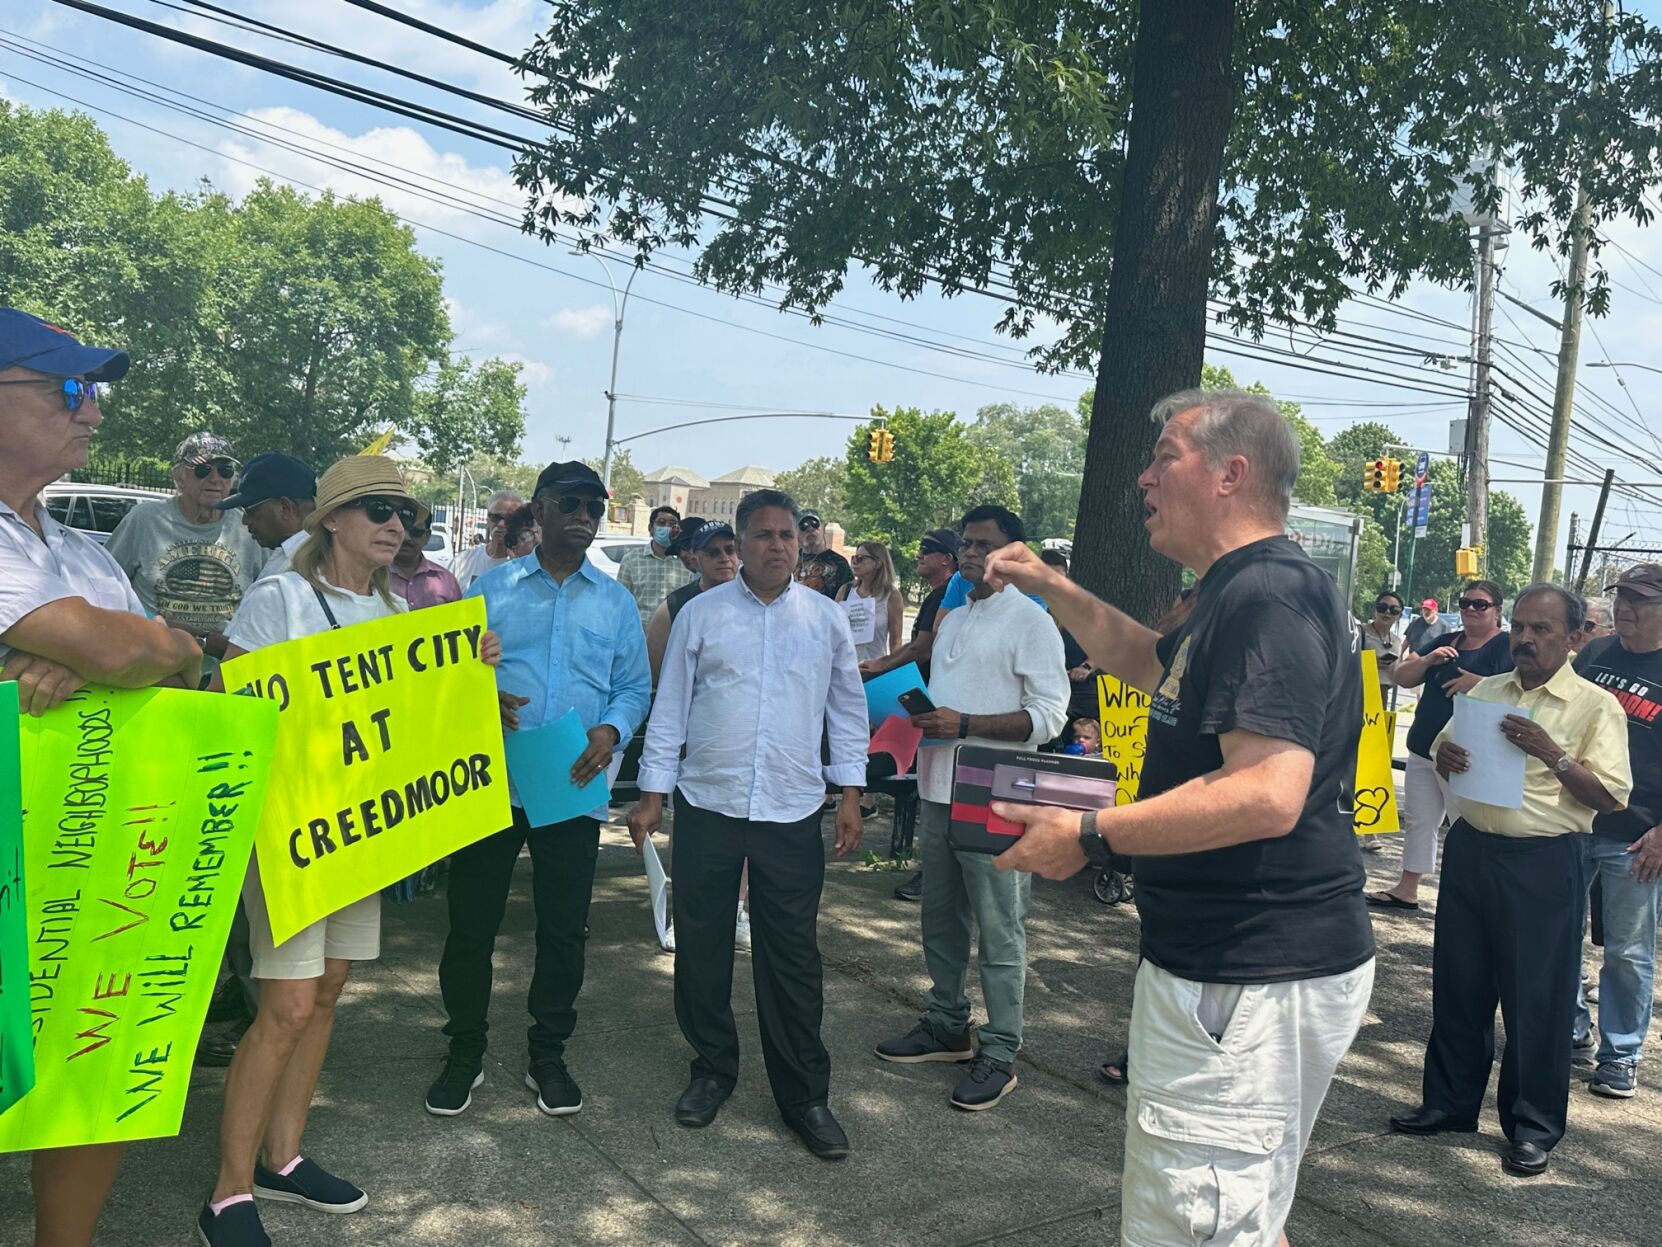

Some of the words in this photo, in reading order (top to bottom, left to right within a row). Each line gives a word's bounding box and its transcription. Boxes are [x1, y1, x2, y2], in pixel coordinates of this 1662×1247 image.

[192, 604, 208, 612] WE
[310, 644, 394, 699] TENT
[407, 624, 482, 672] CITY
[1595, 672, 1627, 690] LET'S
[1628, 682, 1649, 697] GO
[341, 707, 391, 767] AT
[1103, 745, 1120, 759] To
[1104, 720, 1140, 738] Our
[288, 753, 492, 869] CREEDMOOR
[30, 888, 81, 1049] SIDENTIAL
[66, 971, 132, 1063] WE
[116, 1041, 172, 1122] WE
